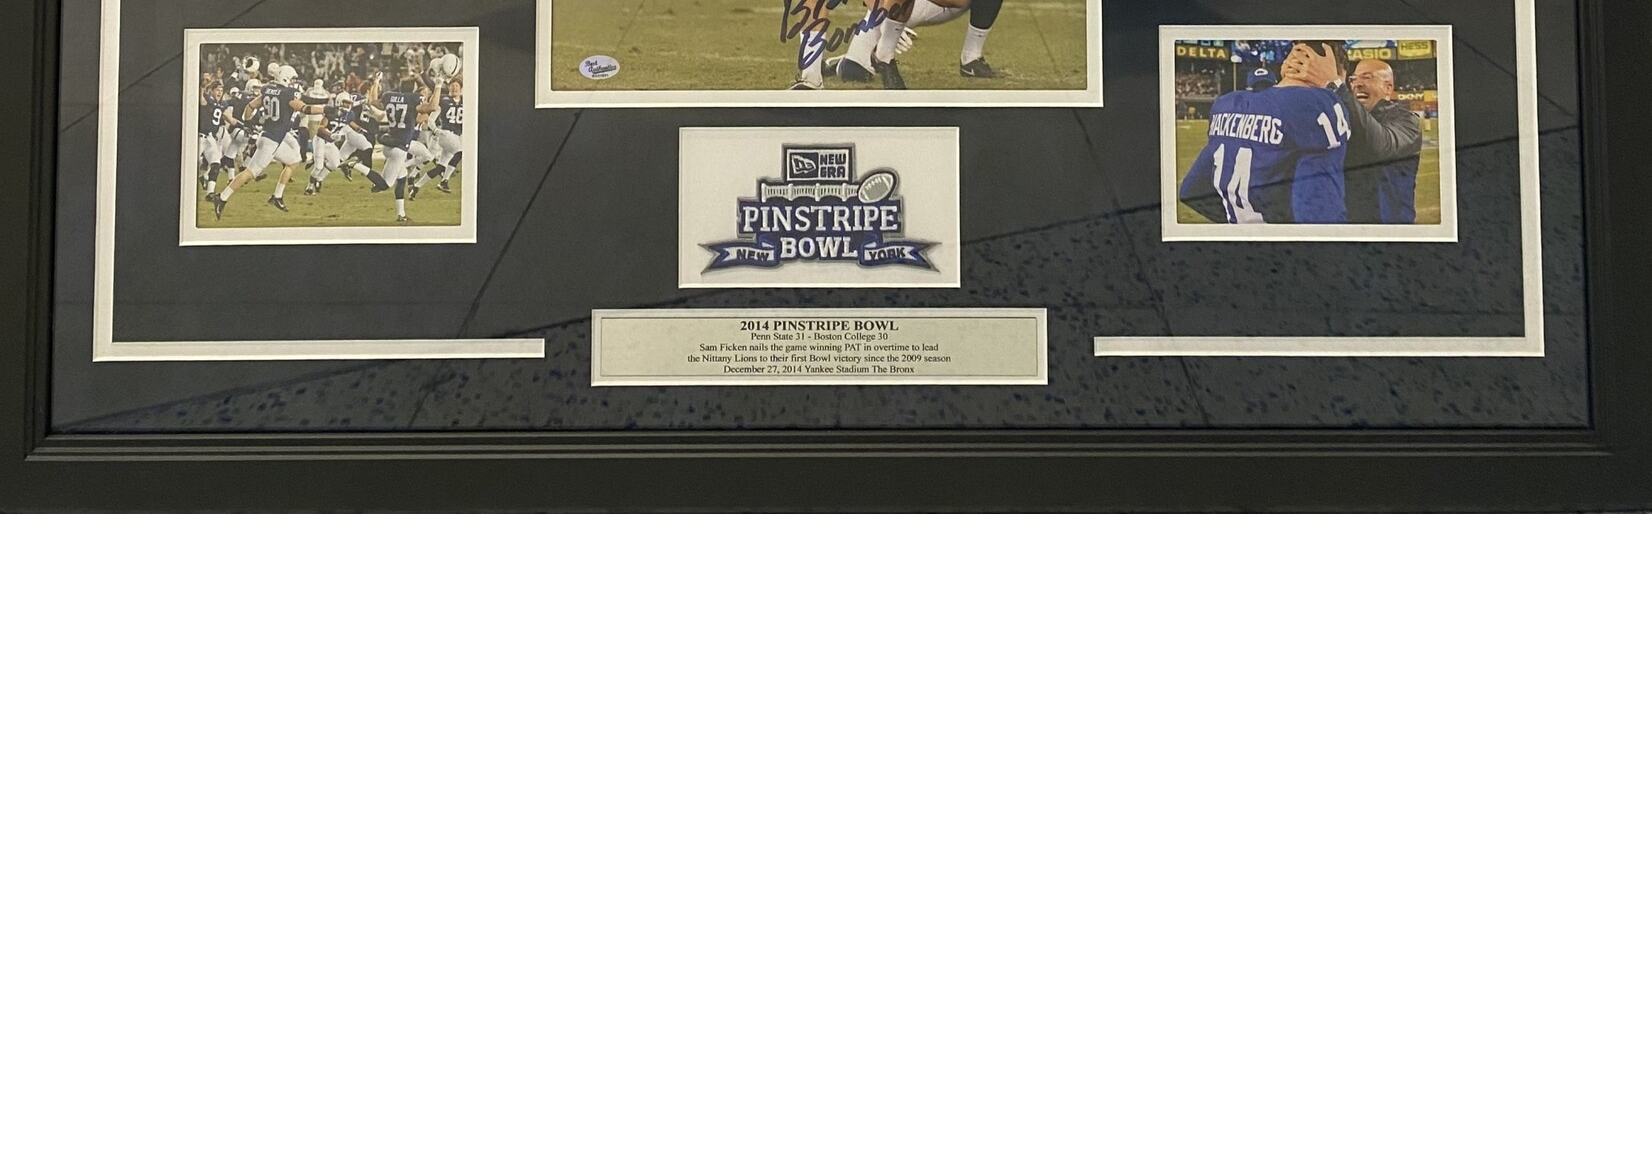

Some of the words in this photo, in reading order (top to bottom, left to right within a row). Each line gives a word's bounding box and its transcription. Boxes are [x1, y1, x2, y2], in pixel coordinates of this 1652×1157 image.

[1176, 46, 1226, 59] DELTA
[1401, 41, 1429, 51] HESS
[263, 96, 280, 121] 90
[212, 108, 223, 126] 9
[386, 103, 409, 129] 37
[1316, 102, 1352, 150] 14
[820, 153, 847, 165] NEW
[820, 165, 846, 178] ERA
[1213, 143, 1266, 224] 14
[742, 205, 898, 232] PINSTRIPE
[736, 247, 770, 262] NEW
[868, 246, 907, 261] YORK
[780, 236, 859, 259] BOWL
[739, 320, 770, 332] 2014
[773, 320, 850, 332] PINSTRIPE
[854, 320, 899, 332] BOWL
[750, 332, 771, 341] Penn
[773, 332, 794, 341] State
[795, 332, 805, 341] 31
[813, 332, 843, 341] Boston
[844, 332, 876, 342] College
[877, 332, 888, 341] 30
[699, 343, 717, 352] Sam
[720, 343, 748, 352] Ficken
[749, 343, 768, 352] nails
[770, 343, 783, 352] the
[785, 343, 807, 353] game
[809, 343, 843, 353] winning
[844, 343, 862, 352] PAT
[863, 343, 872, 352] in
[873, 343, 910, 352] overtime
[911, 343, 920, 352] to
[921, 343, 939, 352] lead
[687, 354, 700, 362] the
[702, 354, 732, 364] Nittany
[734, 354, 758, 362] Lions
[759, 354, 768, 362] to
[769, 354, 790, 362] their
[791, 354, 807, 362] first
[809, 354, 831, 362] Bowl
[833, 354, 862, 364] victory
[863, 354, 886, 362] since
[887, 354, 900, 362] the
[901, 354, 922, 362] 2009
[923, 354, 952, 362] season
[723, 364, 765, 374] December
[767, 364, 780, 374] 27,
[782, 364, 802, 374] 2014
[804, 364, 834, 374] Yankee
[836, 364, 870, 374] Stadium
[871, 364, 888, 374] The
[889, 364, 915, 374] Bronx
